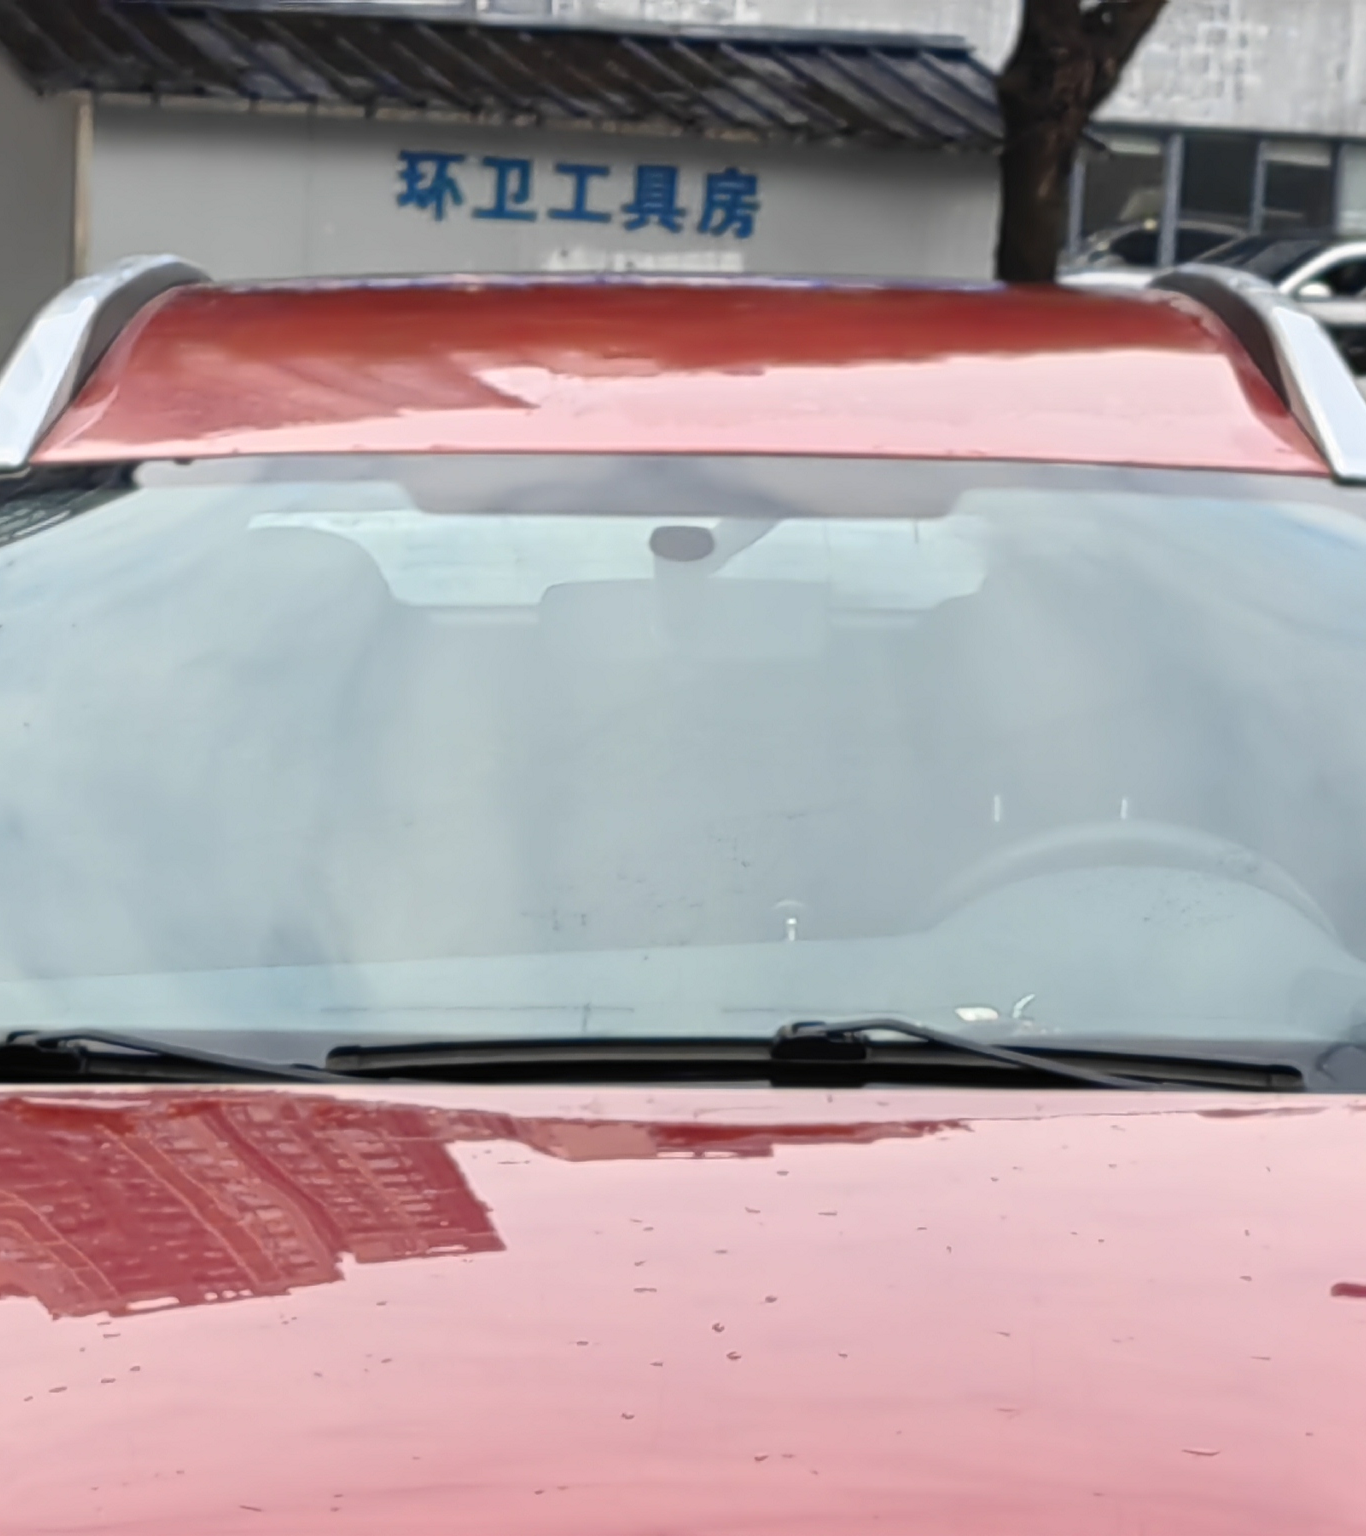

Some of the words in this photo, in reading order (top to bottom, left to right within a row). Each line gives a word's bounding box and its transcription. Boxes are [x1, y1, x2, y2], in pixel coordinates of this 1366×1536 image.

[396, 150, 760, 239] 环卫工具房
